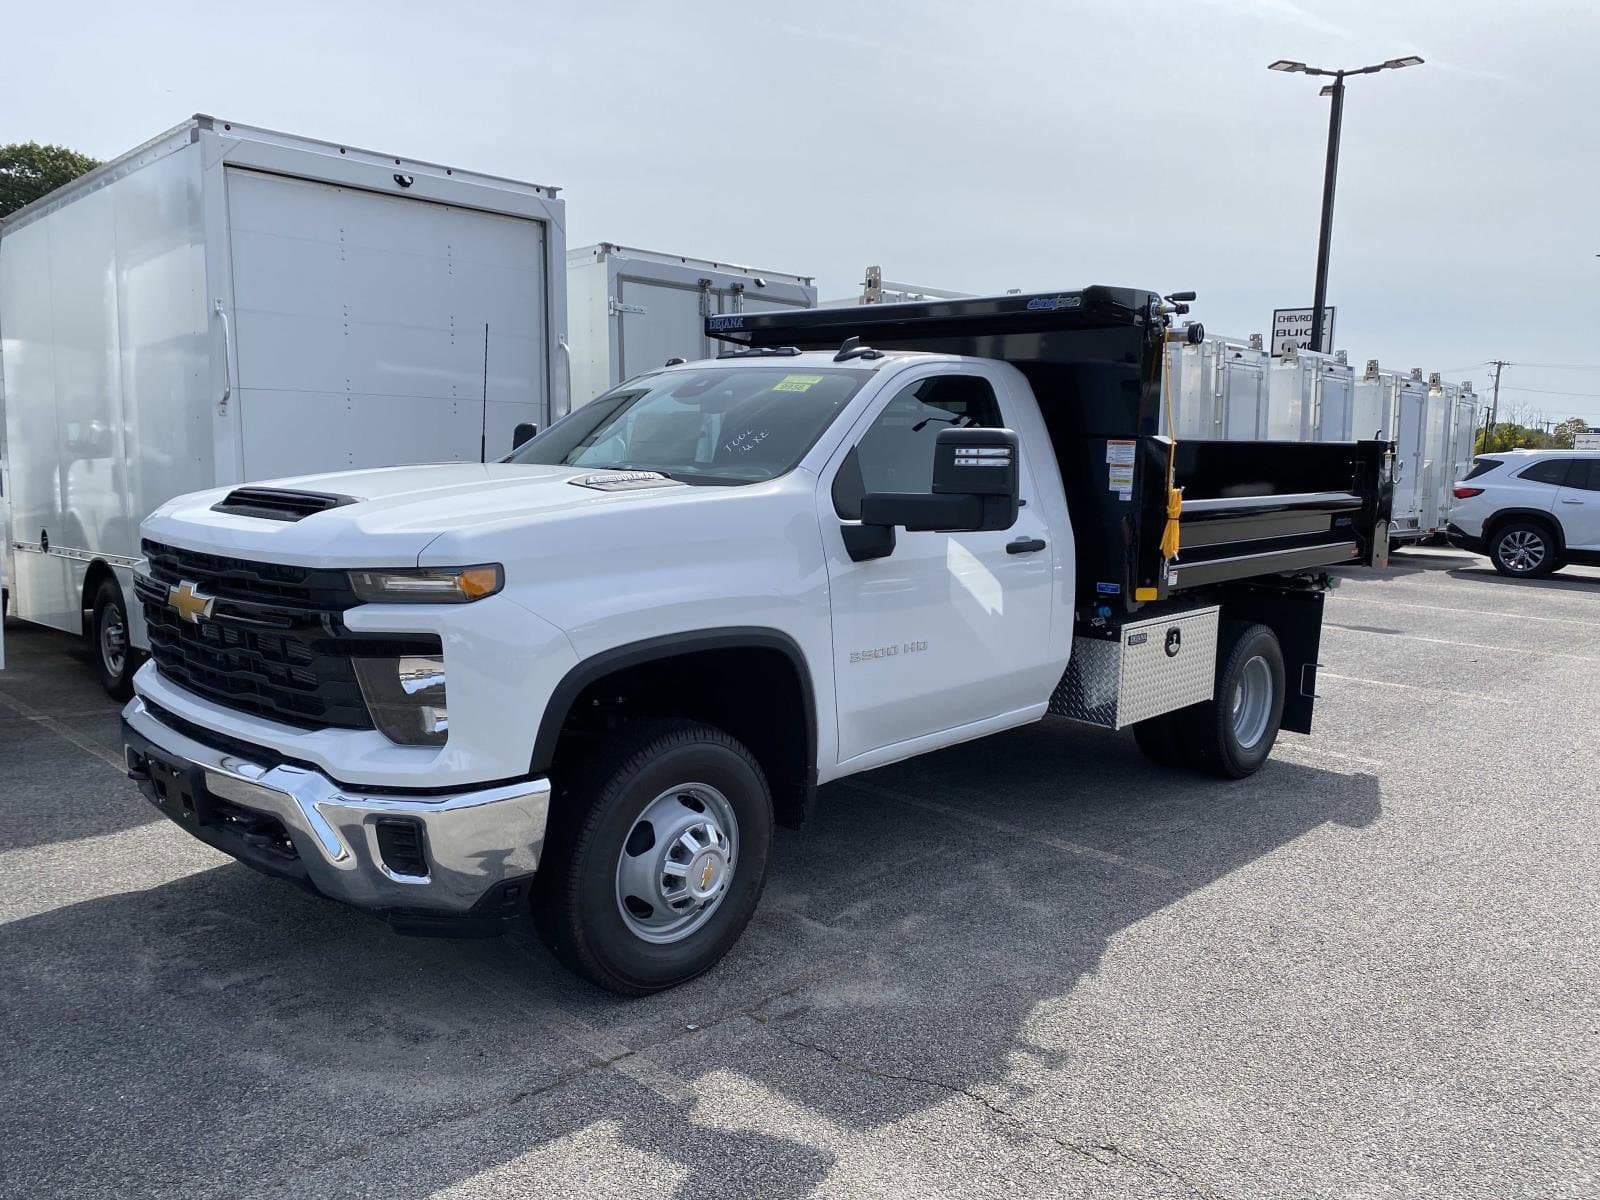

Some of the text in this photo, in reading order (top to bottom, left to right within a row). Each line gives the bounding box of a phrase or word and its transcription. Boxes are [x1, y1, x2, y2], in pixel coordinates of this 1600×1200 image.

[709, 317, 745, 331] DEJANA
[1276, 327, 1327, 337] BUIC
[903, 641, 928, 654] HD
